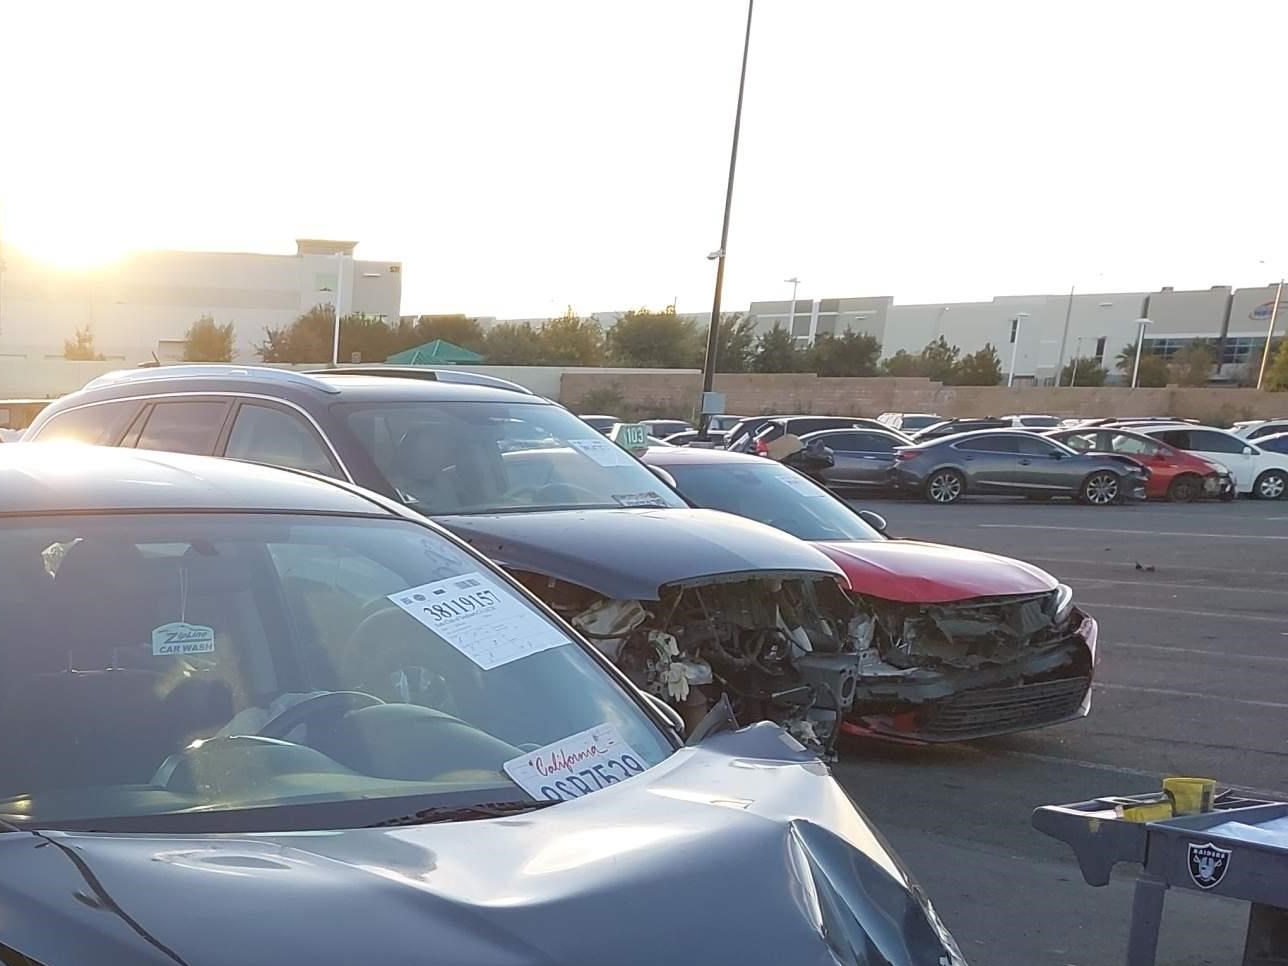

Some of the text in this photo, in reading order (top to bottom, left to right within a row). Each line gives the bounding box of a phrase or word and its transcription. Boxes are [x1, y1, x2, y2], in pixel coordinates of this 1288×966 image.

[627, 427, 644, 443] 103
[424, 590, 502, 622] 38119157
[159, 643, 212, 653] CAR WASH
[536, 745, 608, 776] California
[1193, 849, 1225, 858] RAIDERS
